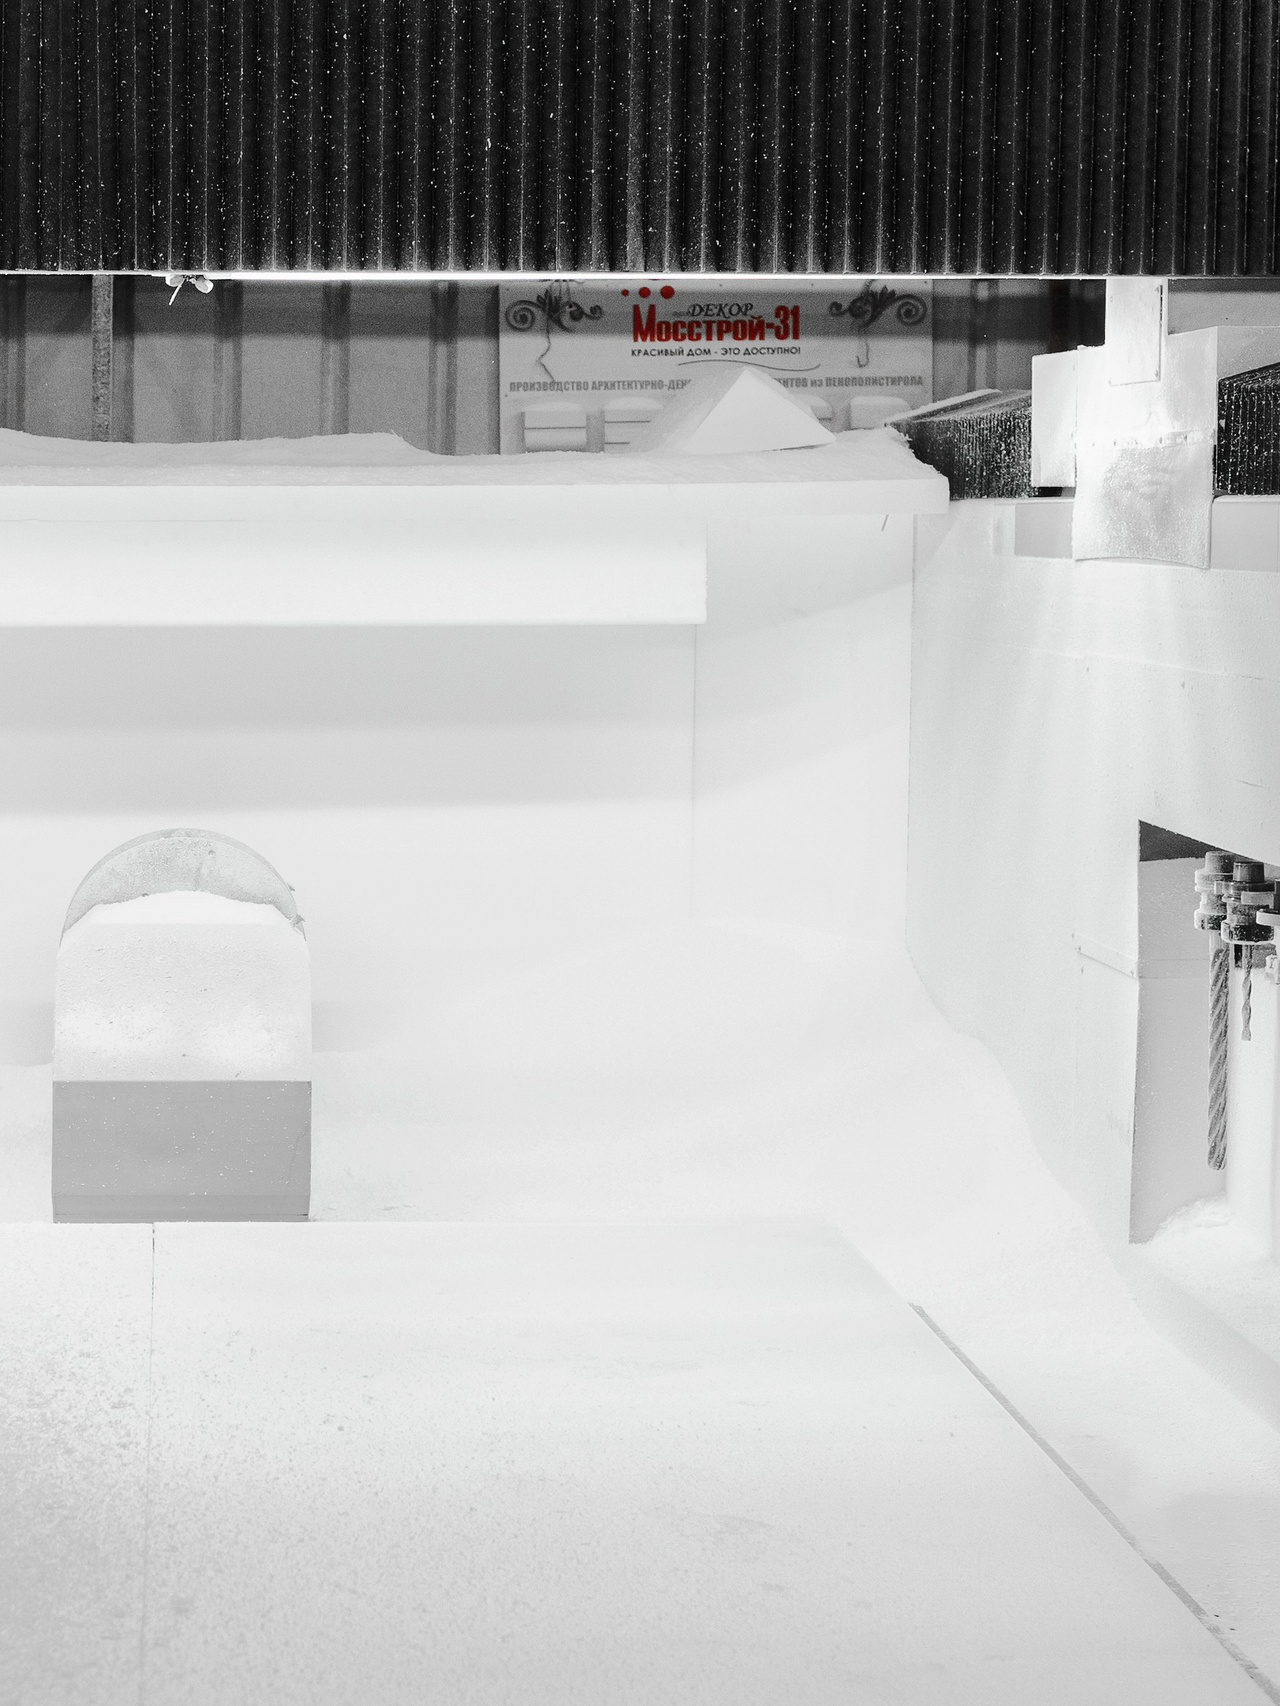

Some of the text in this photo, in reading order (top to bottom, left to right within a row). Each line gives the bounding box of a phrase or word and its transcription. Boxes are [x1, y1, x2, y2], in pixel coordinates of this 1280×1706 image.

[631, 347, 685, 357] КРАСИВЫЙ
[686, 348, 712, 357] ДОМ
[721, 347, 741, 357] ЭТО
[743, 347, 801, 357] ДОСТУПНО!
[509, 381, 589, 392] ПРОИЗВОДСТВО
